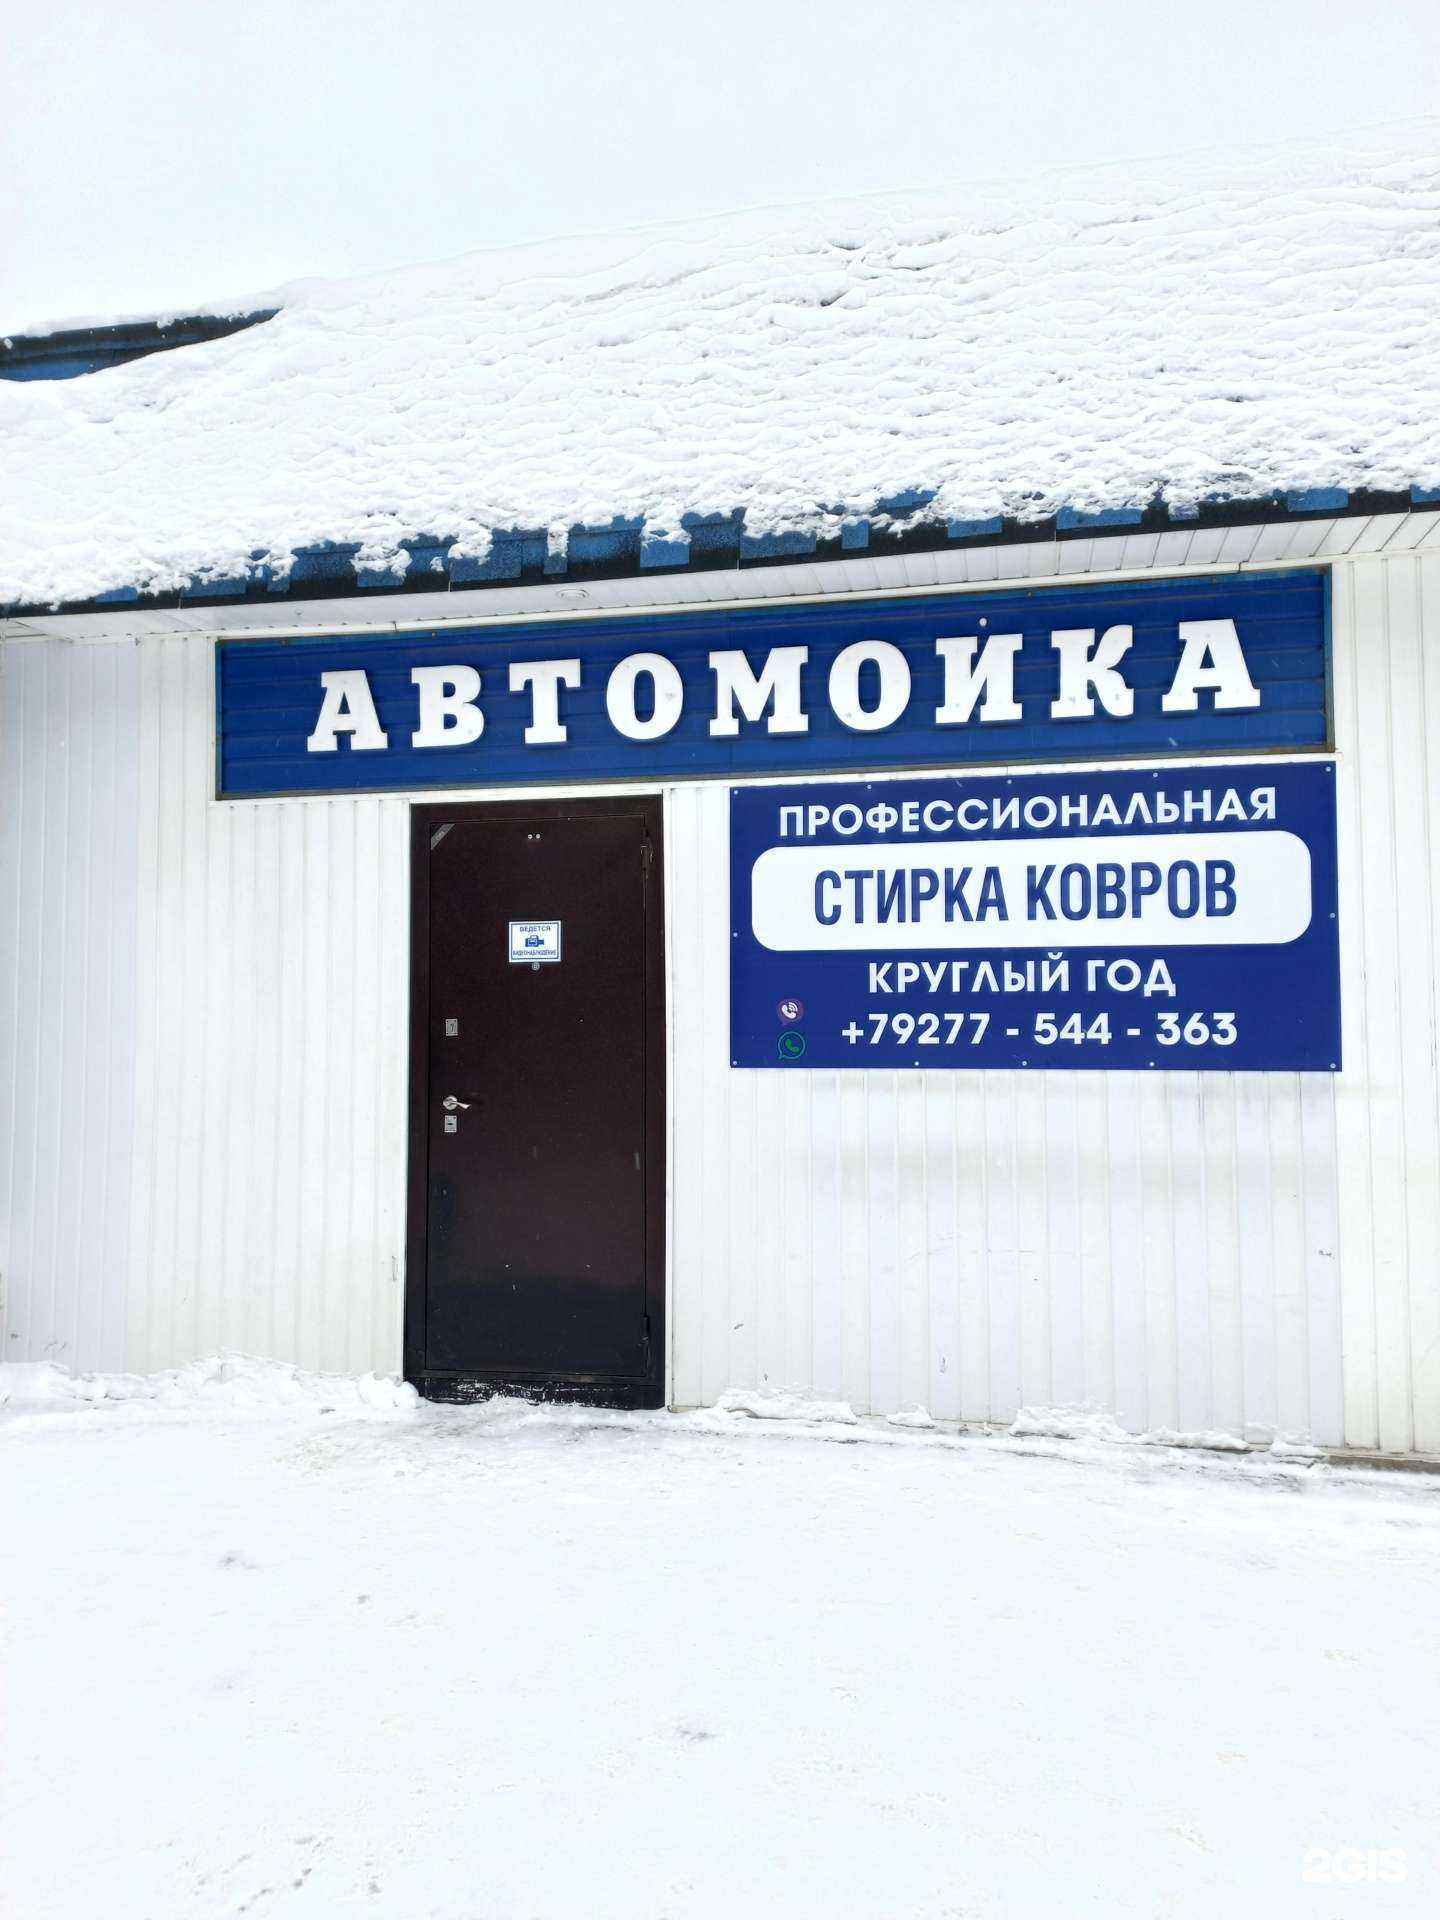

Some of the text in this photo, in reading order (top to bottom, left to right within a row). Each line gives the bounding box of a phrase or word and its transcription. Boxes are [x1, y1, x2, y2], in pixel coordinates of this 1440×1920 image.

[778, 787, 1277, 836] ПРОФЕССИОНАЛЬНАЯ
[814, 860, 1237, 926] СТИРКА КОВРОВ
[869, 952, 1177, 997] КРУГЛЫЙ ГОД
[841, 1012, 990, 1045] +79277
[1033, 1012, 1113, 1045] 544
[1155, 1012, 1238, 1046] 363
